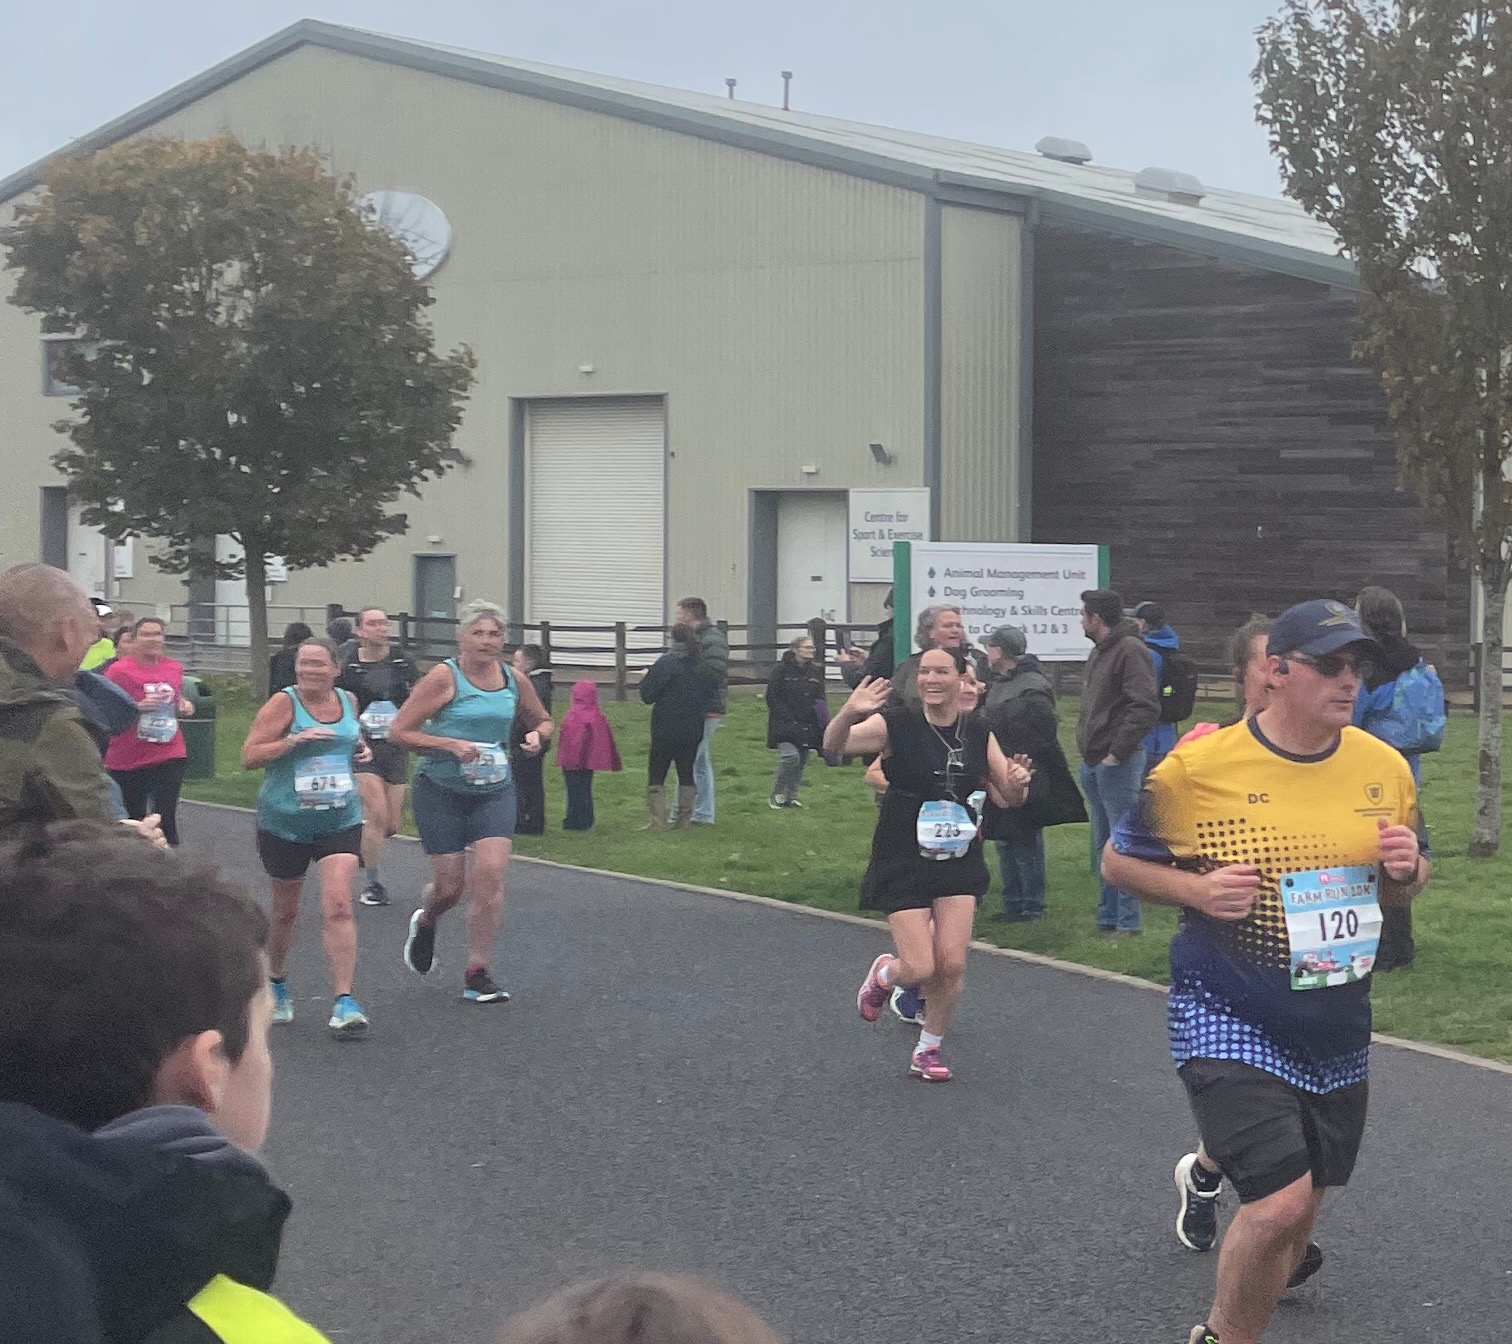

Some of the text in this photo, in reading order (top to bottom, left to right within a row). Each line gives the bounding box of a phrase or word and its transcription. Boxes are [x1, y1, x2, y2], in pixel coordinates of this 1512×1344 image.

[864, 511, 894, 523] Centre
[852, 528, 876, 542] Sport
[887, 528, 924, 540] Exercise
[870, 545, 894, 557] Scien
[943, 567, 1087, 581] Animal Management Unit
[943, 586, 1025, 600] Dog Grooming
[962, 604, 1080, 618] hnology & Skills Centr
[968, 623, 981, 634] to
[1050, 623, 1060, 634] &
[1061, 623, 1069, 634] 3
[1247, 792, 1270, 804] DC
[1290, 883, 1372, 905] FARM RUN 10K
[1318, 908, 1360, 942] 120
